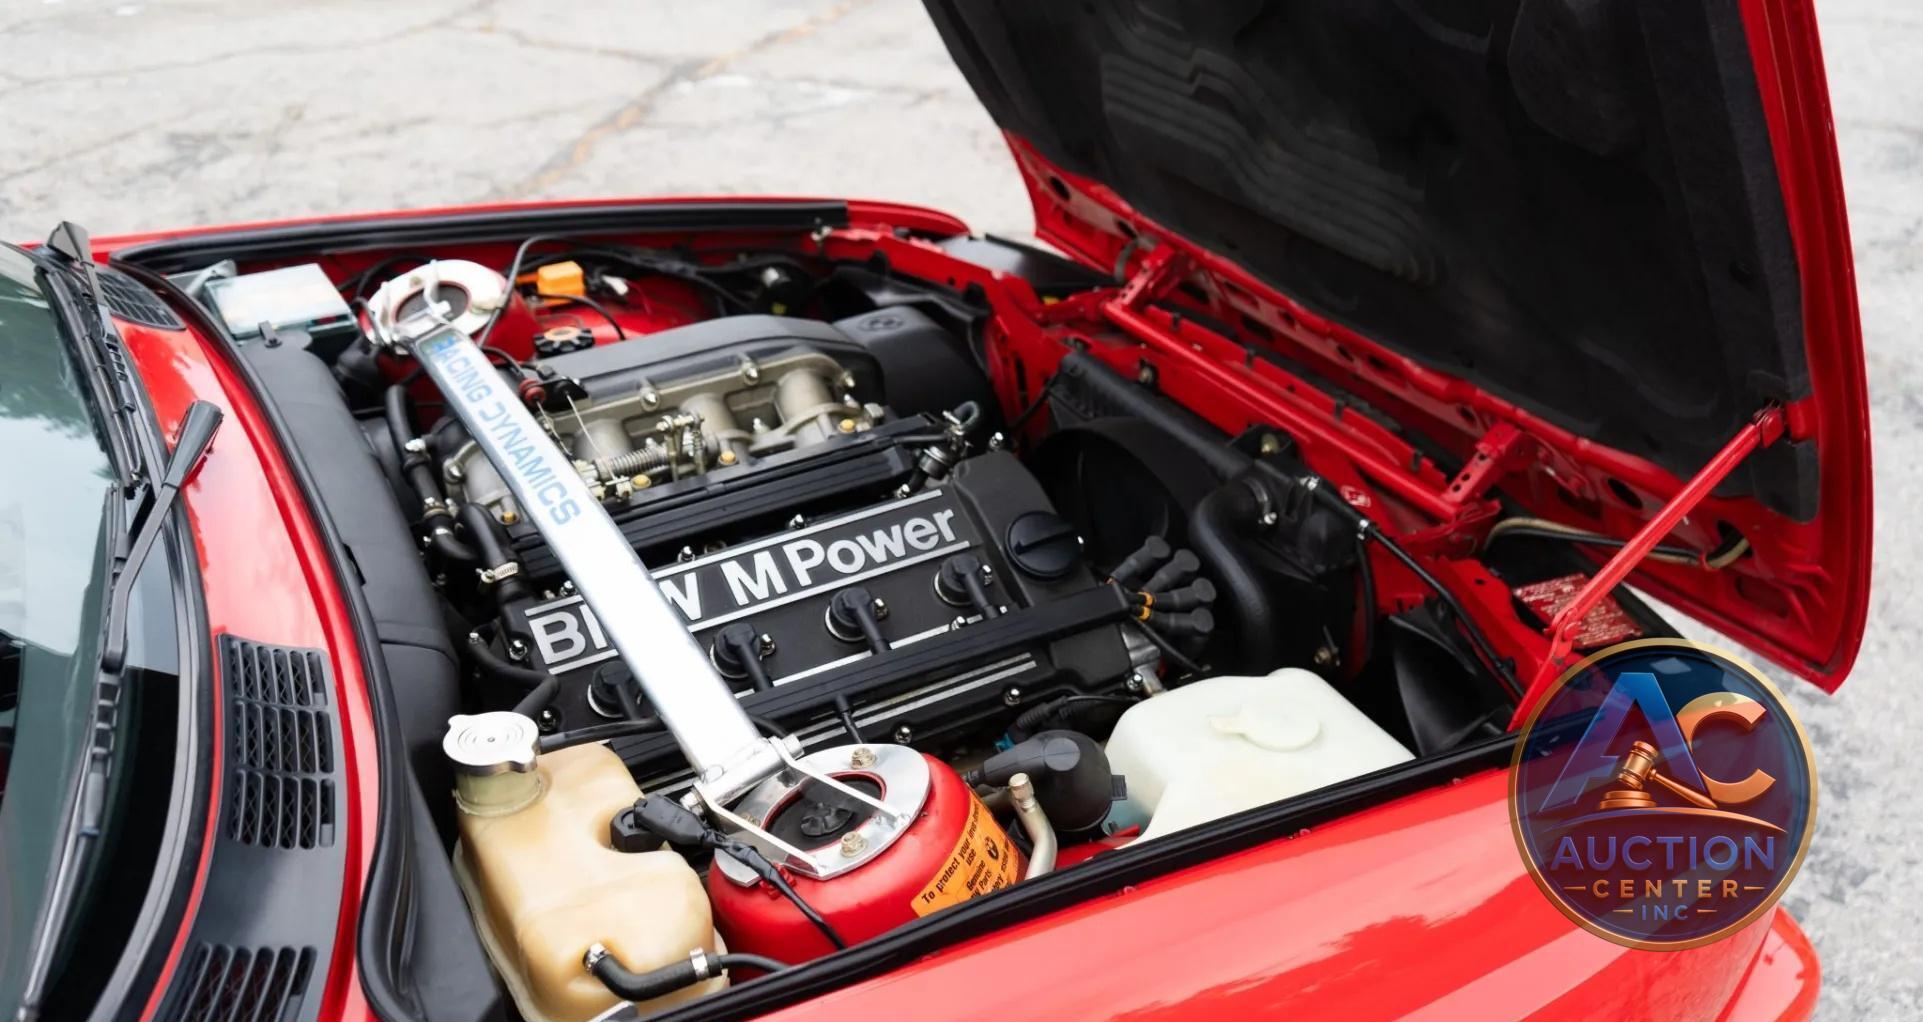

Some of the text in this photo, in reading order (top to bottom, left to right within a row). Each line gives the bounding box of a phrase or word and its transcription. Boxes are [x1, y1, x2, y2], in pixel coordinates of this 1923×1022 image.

[478, 400, 582, 526] DYNAMICS
[921, 837, 971, 905] To protect your
[966, 848, 977, 867] use
[967, 860, 986, 891] Genuine
[979, 869, 993, 890] Parts
